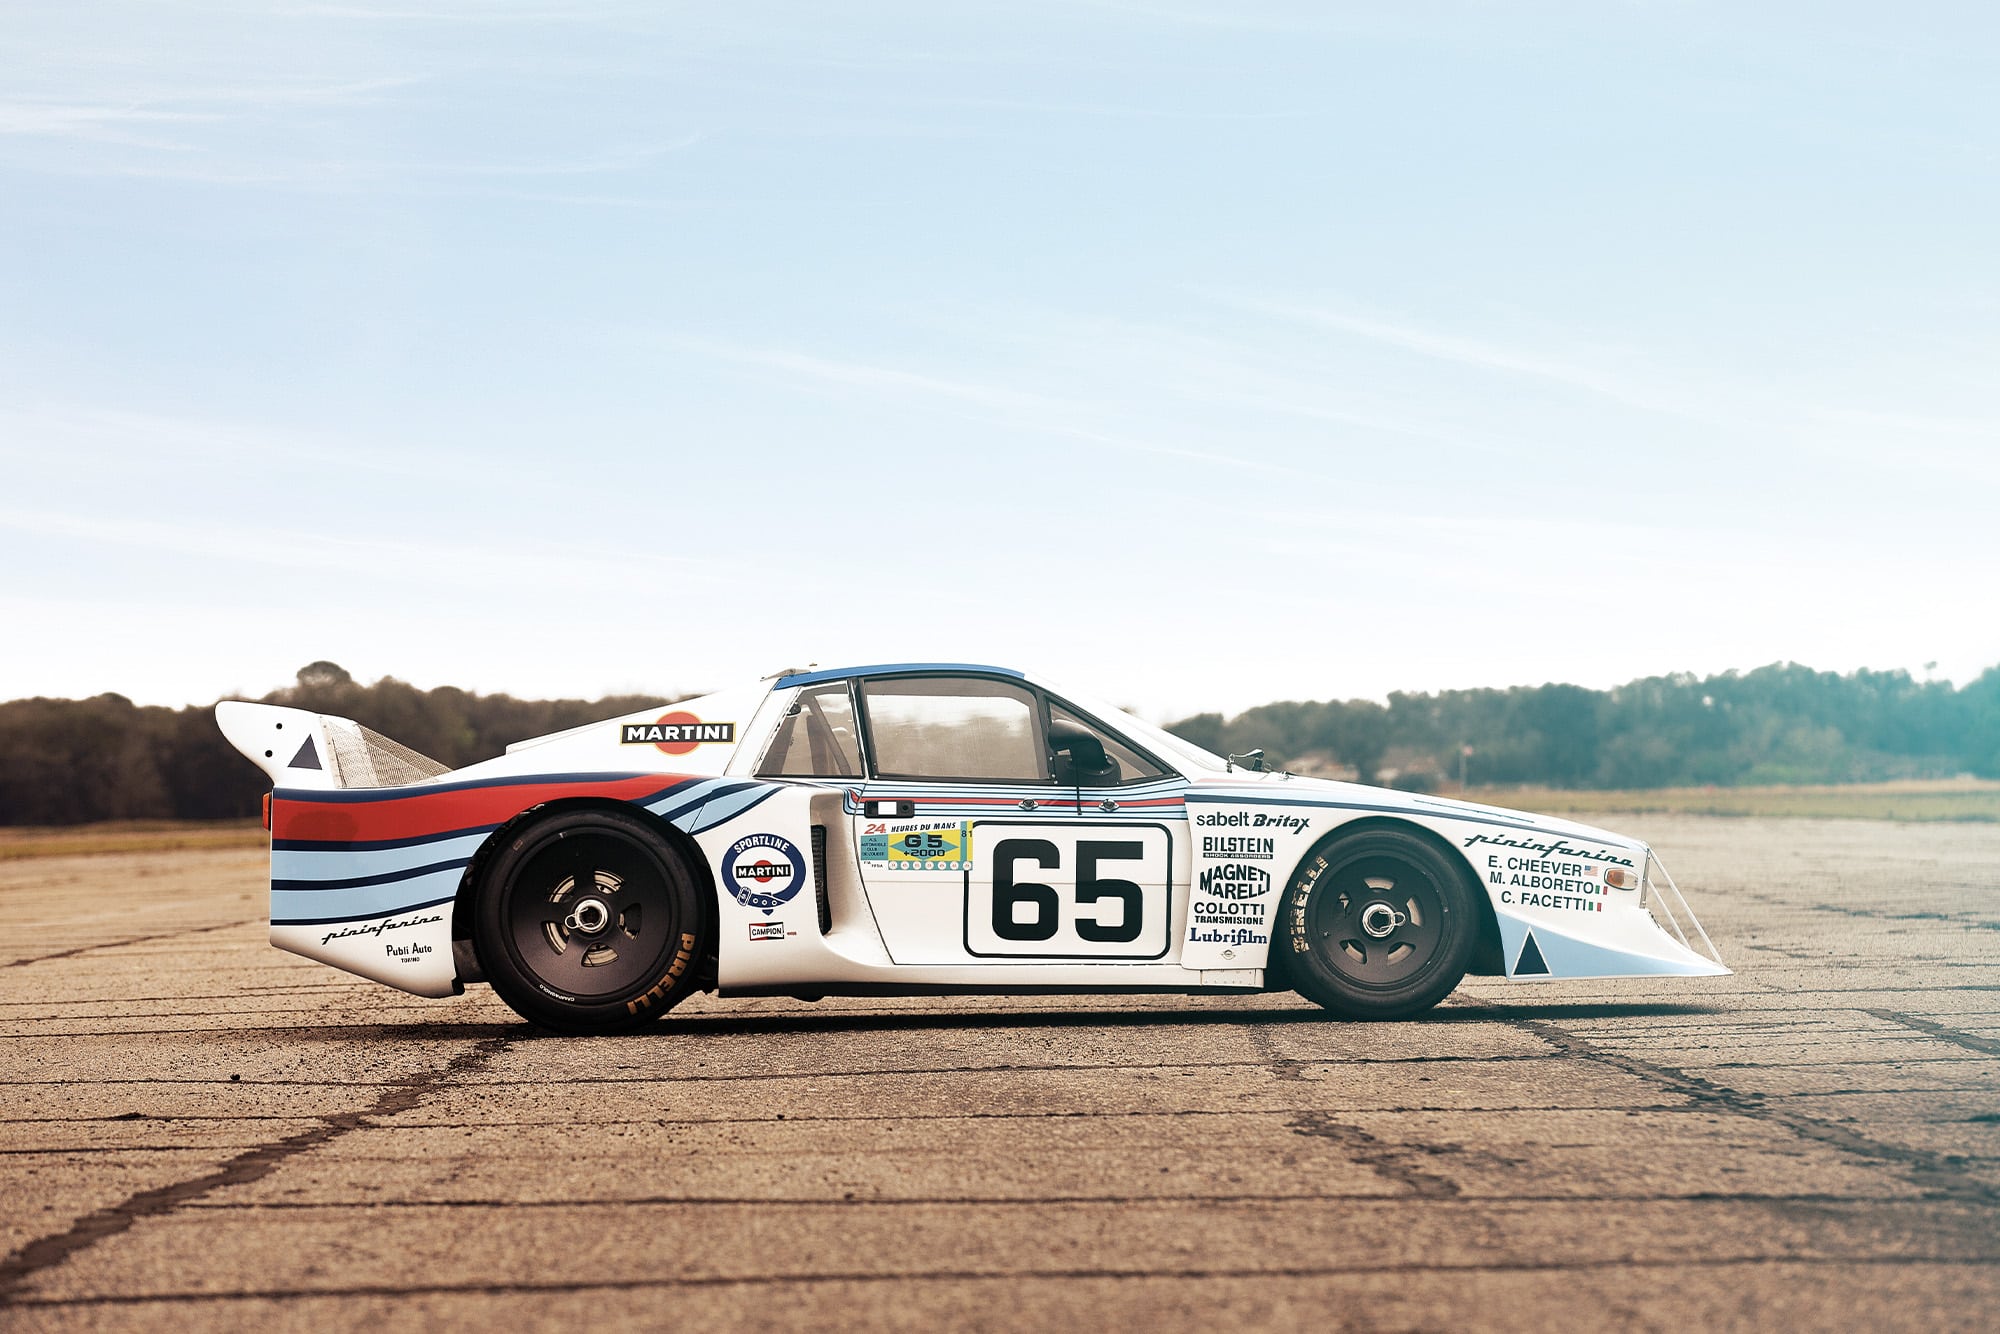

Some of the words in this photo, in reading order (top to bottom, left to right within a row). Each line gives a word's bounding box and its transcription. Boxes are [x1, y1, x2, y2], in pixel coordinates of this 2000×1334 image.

[627, 725, 728, 741] MARTINI
[864, 823, 887, 834] 24
[891, 824, 918, 832] HEURES
[933, 822, 956, 830] MANS
[1196, 811, 1249, 827] sabelt
[1252, 814, 1311, 835] Britax
[734, 836, 790, 854] SPORTLINE
[904, 849, 945, 857] +2000
[1203, 837, 1274, 853] BILSTEIN
[1464, 835, 1634, 868] pininfarina
[738, 866, 789, 876] MARTINI
[1488, 855, 1503, 868] E.
[1507, 857, 1582, 877] CHEEVER
[1200, 864, 1271, 888] MAGNETI
[1489, 871, 1506, 885] M.
[1510, 873, 1594, 894] ALBORETO
[987, 839, 1144, 942] 65
[1200, 877, 1271, 900] MARELLI
[1194, 902, 1265, 916] COLOTTI
[1501, 890, 1516, 904] C.
[1520, 893, 1586, 911] FACETTI
[1195, 916, 1264, 925] TRANSMISIONE
[321, 915, 443, 946] pininfarina
[751, 928, 782, 936] CAMPION
[1189, 928, 1267, 946] Lubrifilm
[386, 944, 409, 957] Publi
[412, 942, 433, 954] Auto
[626, 932, 697, 1016] PIRELLI
